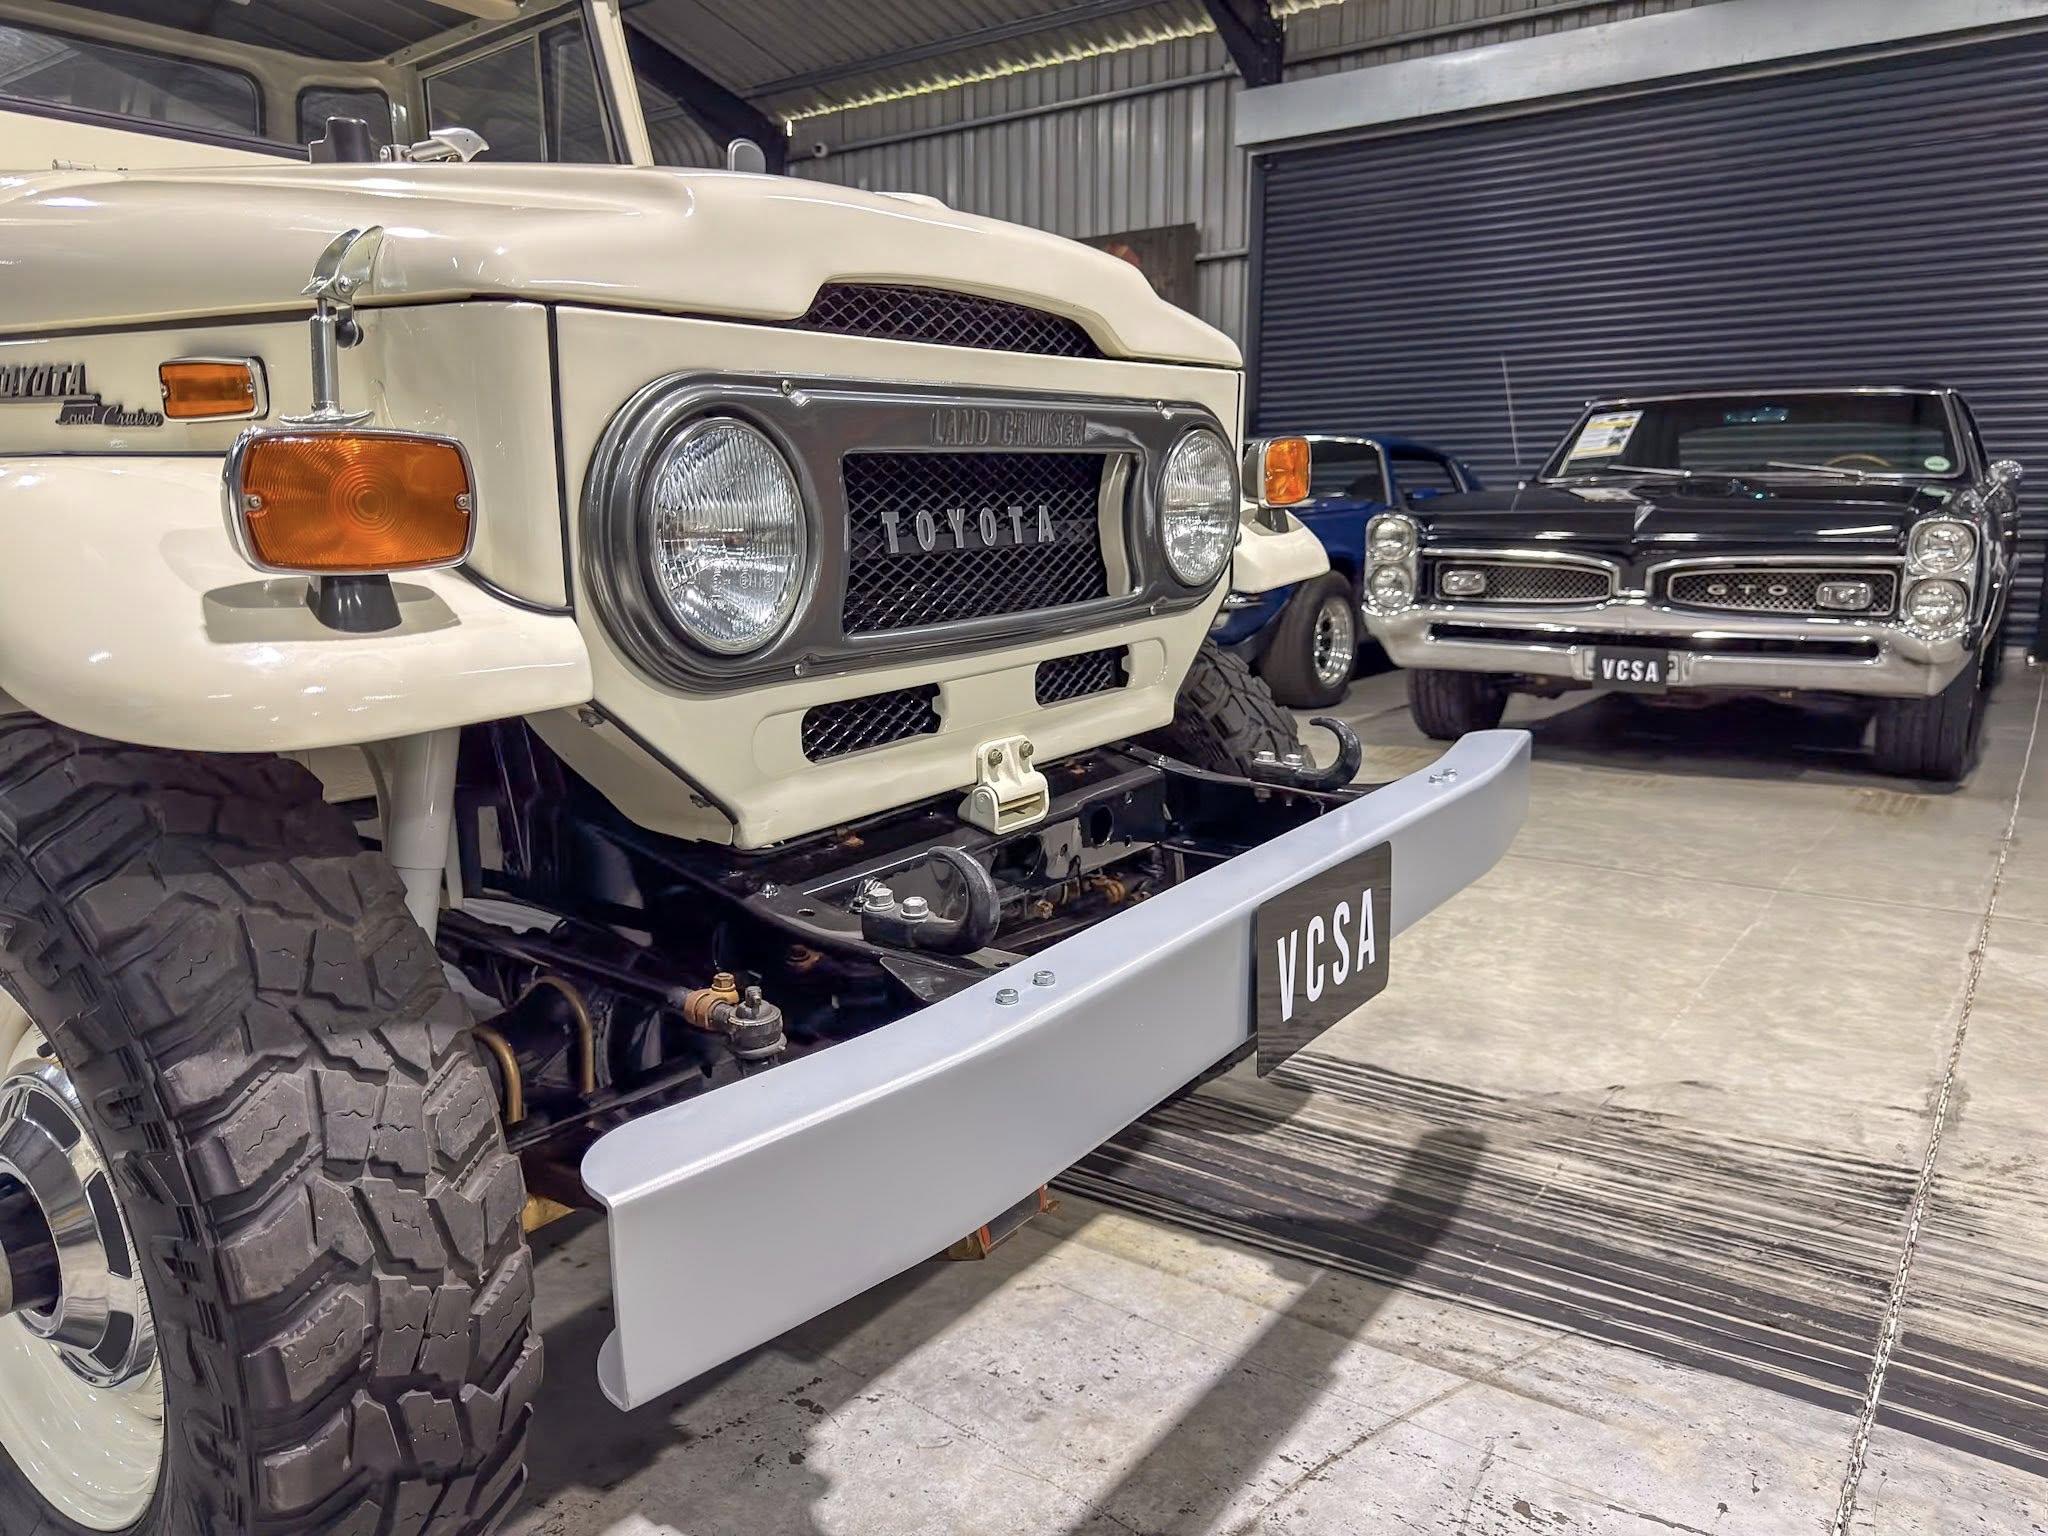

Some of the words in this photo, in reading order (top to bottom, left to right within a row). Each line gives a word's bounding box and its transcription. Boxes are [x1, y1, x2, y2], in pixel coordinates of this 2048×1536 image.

[0, 364, 86, 397] OYOTA
[101, 405, 160, 426] Cruiser
[931, 408, 991, 446] LAND
[1000, 410, 1086, 447] CRUISER
[881, 504, 1055, 553] TOYOTA
[1707, 583, 1788, 596] GTO
[1601, 658, 1659, 682] VCSA
[1277, 888, 1376, 1022] VCSA
